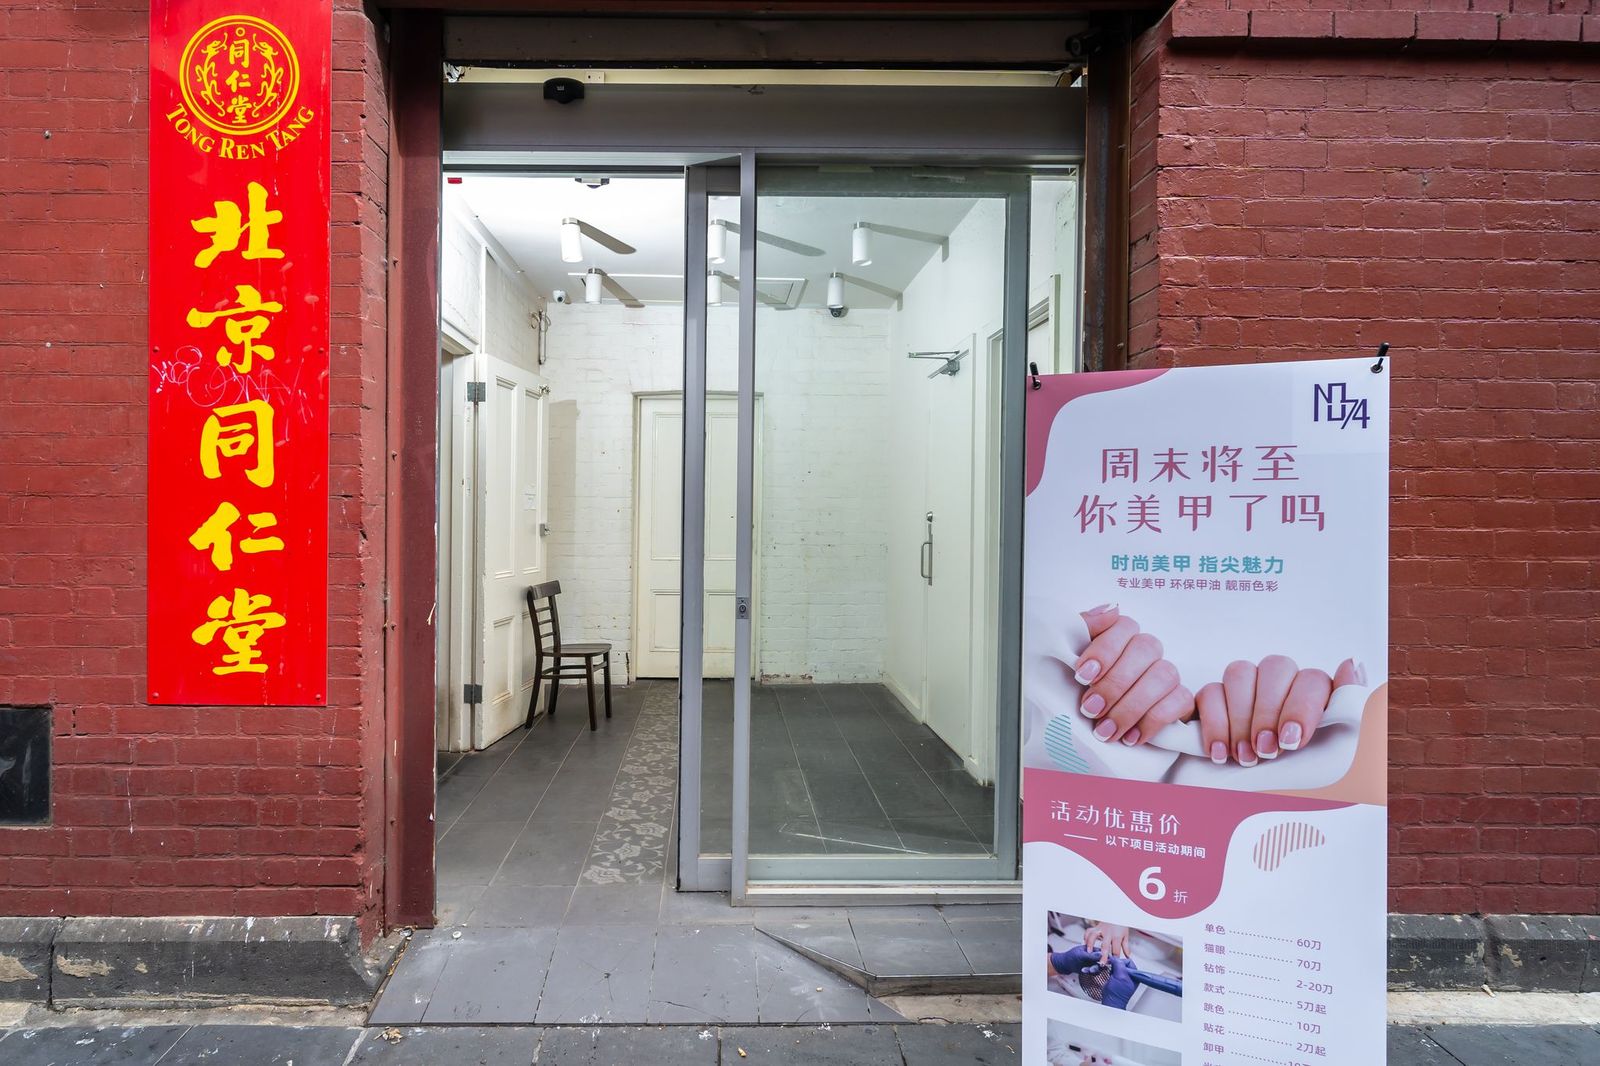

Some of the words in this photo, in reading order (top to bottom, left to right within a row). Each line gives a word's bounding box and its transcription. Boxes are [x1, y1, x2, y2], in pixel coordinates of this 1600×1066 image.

[225, 38, 252, 124] 同仁堂
[165, 102, 216, 153] TONG
[218, 136, 266, 160] REN
[265, 105, 315, 152] TANG
[186, 181, 287, 676] 北京同仁堂
[1101, 444, 1300, 484] 周末将至
[1073, 493, 1325, 535] 你美甲了吗
[1111, 554, 1191, 573] 时尚美甲
[1198, 555, 1284, 575] 指尖魅力
[1117, 577, 1166, 590] 专业美甲
[1170, 578, 1221, 591] 环保甲油
[1225, 579, 1279, 593] 靓丽色彩
[1050, 799, 1181, 836] 活动优惠价
[1105, 834, 1206, 859] 以下项目活动期间
[1138, 866, 1167, 901] 6
[1173, 889, 1189, 904] 折
[1204, 923, 1226, 935] 单色
[1296, 938, 1322, 951] 60刀
[1203, 943, 1226, 955] 猫眼
[1296, 958, 1322, 972] 70刀
[1203, 962, 1226, 975] 钻饰
[1296, 979, 1334, 995] 2-20刀
[1203, 982, 1226, 995] 款式
[1296, 1000, 1327, 1015] 5刀起
[1203, 1002, 1225, 1015] 跳色
[1296, 1021, 1321, 1034] 10刀
[1203, 1022, 1225, 1036] 贴花
[1296, 1042, 1327, 1057] 2刀起
[1203, 1041, 1225, 1055] 卸甲
